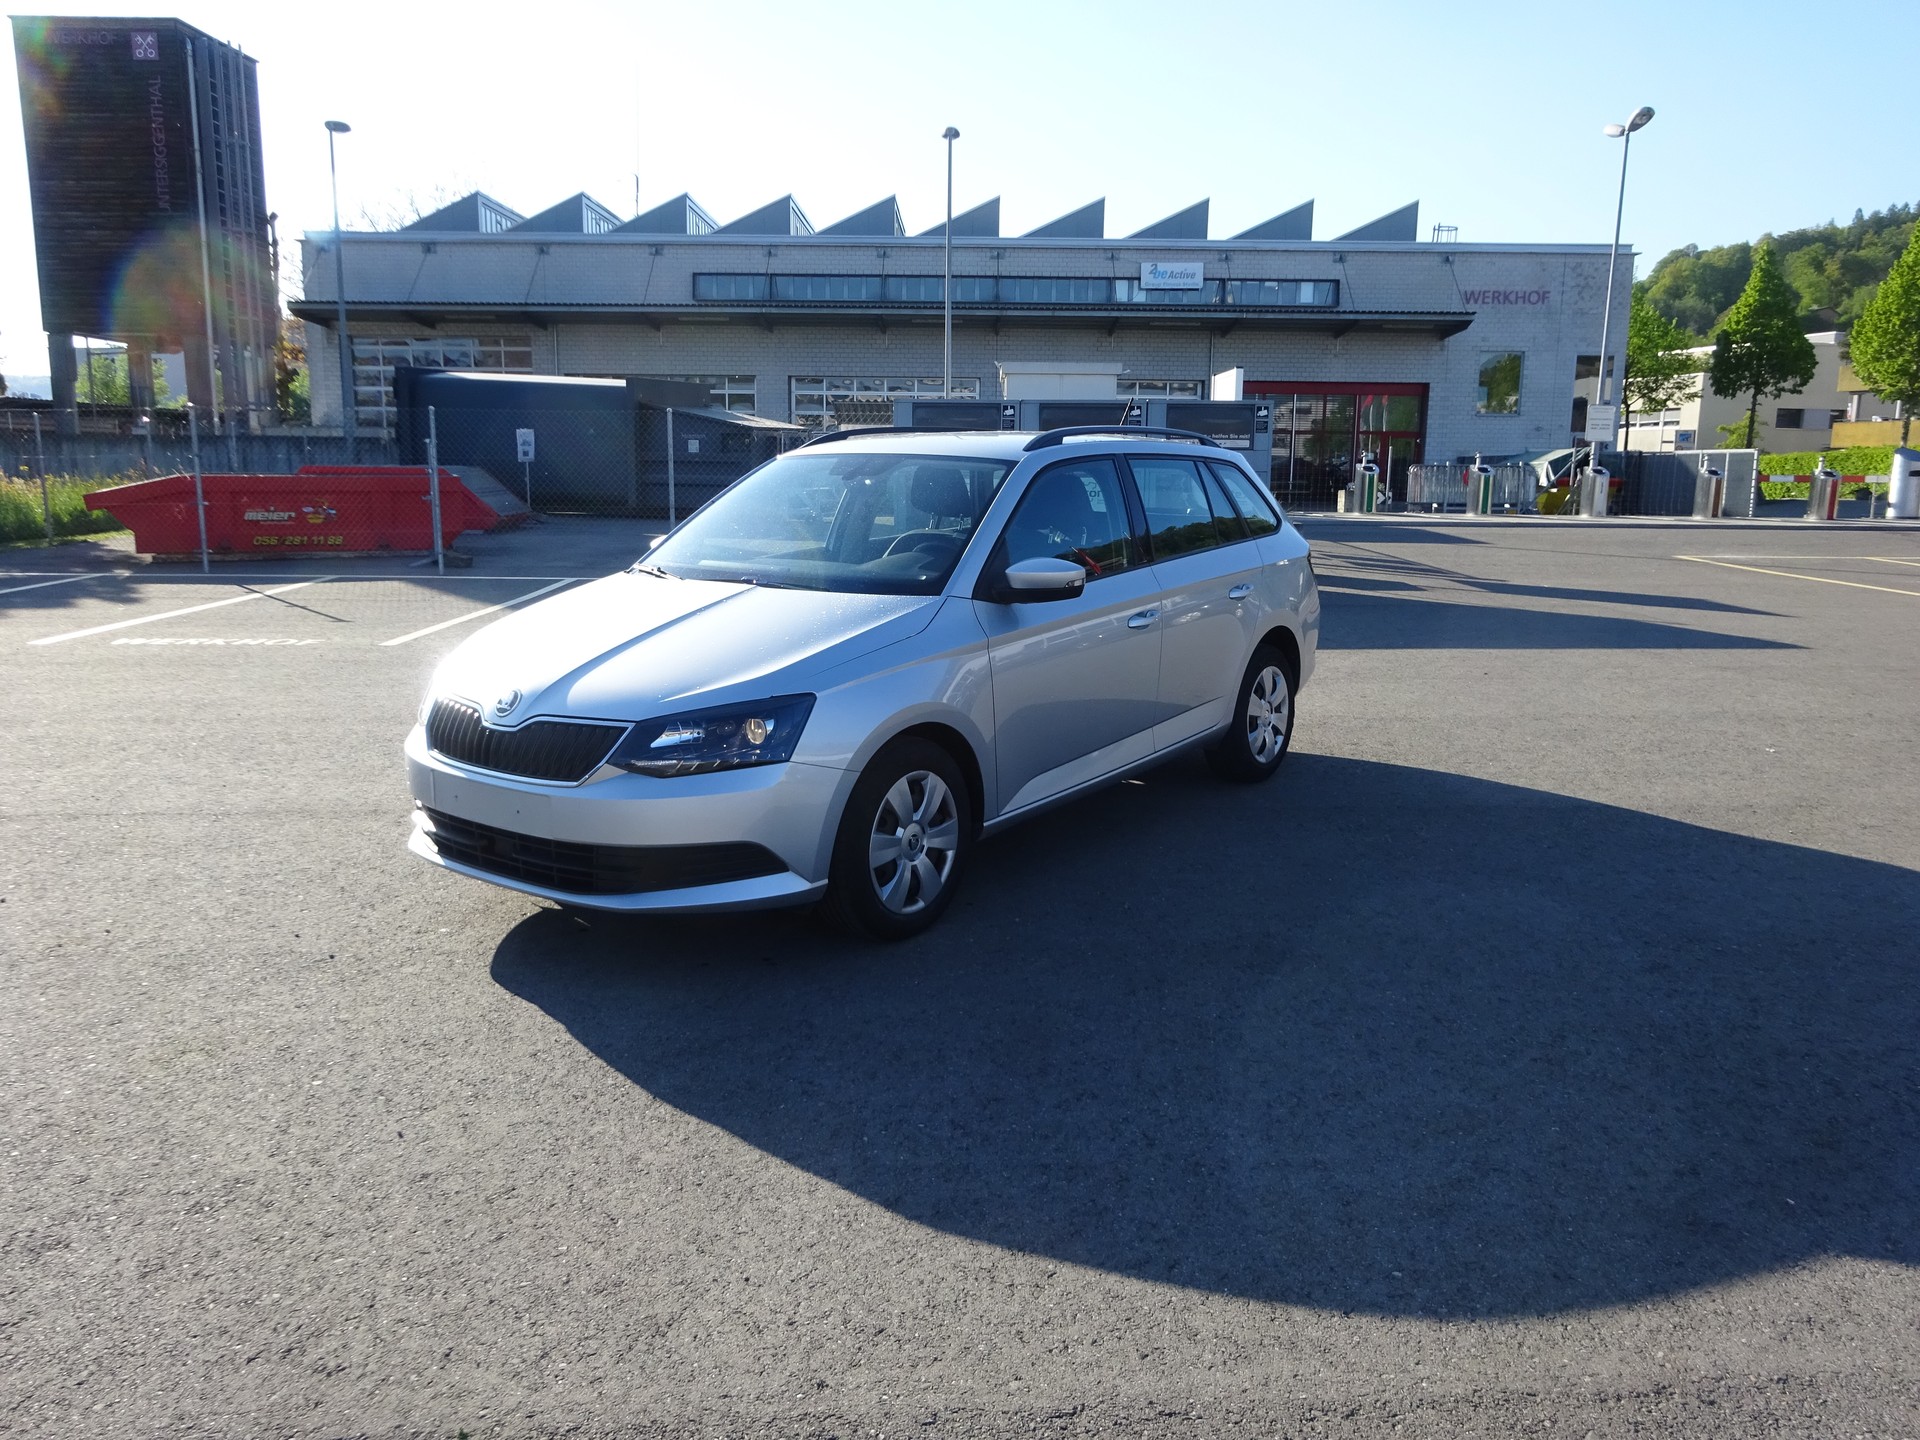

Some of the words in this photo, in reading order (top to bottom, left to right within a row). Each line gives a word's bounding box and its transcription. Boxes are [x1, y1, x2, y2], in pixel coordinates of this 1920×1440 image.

[148, 76, 172, 215] UNTERSIGGENTHAL
[1464, 290, 1551, 305] WERKHOF
[244, 506, 296, 521] meier
